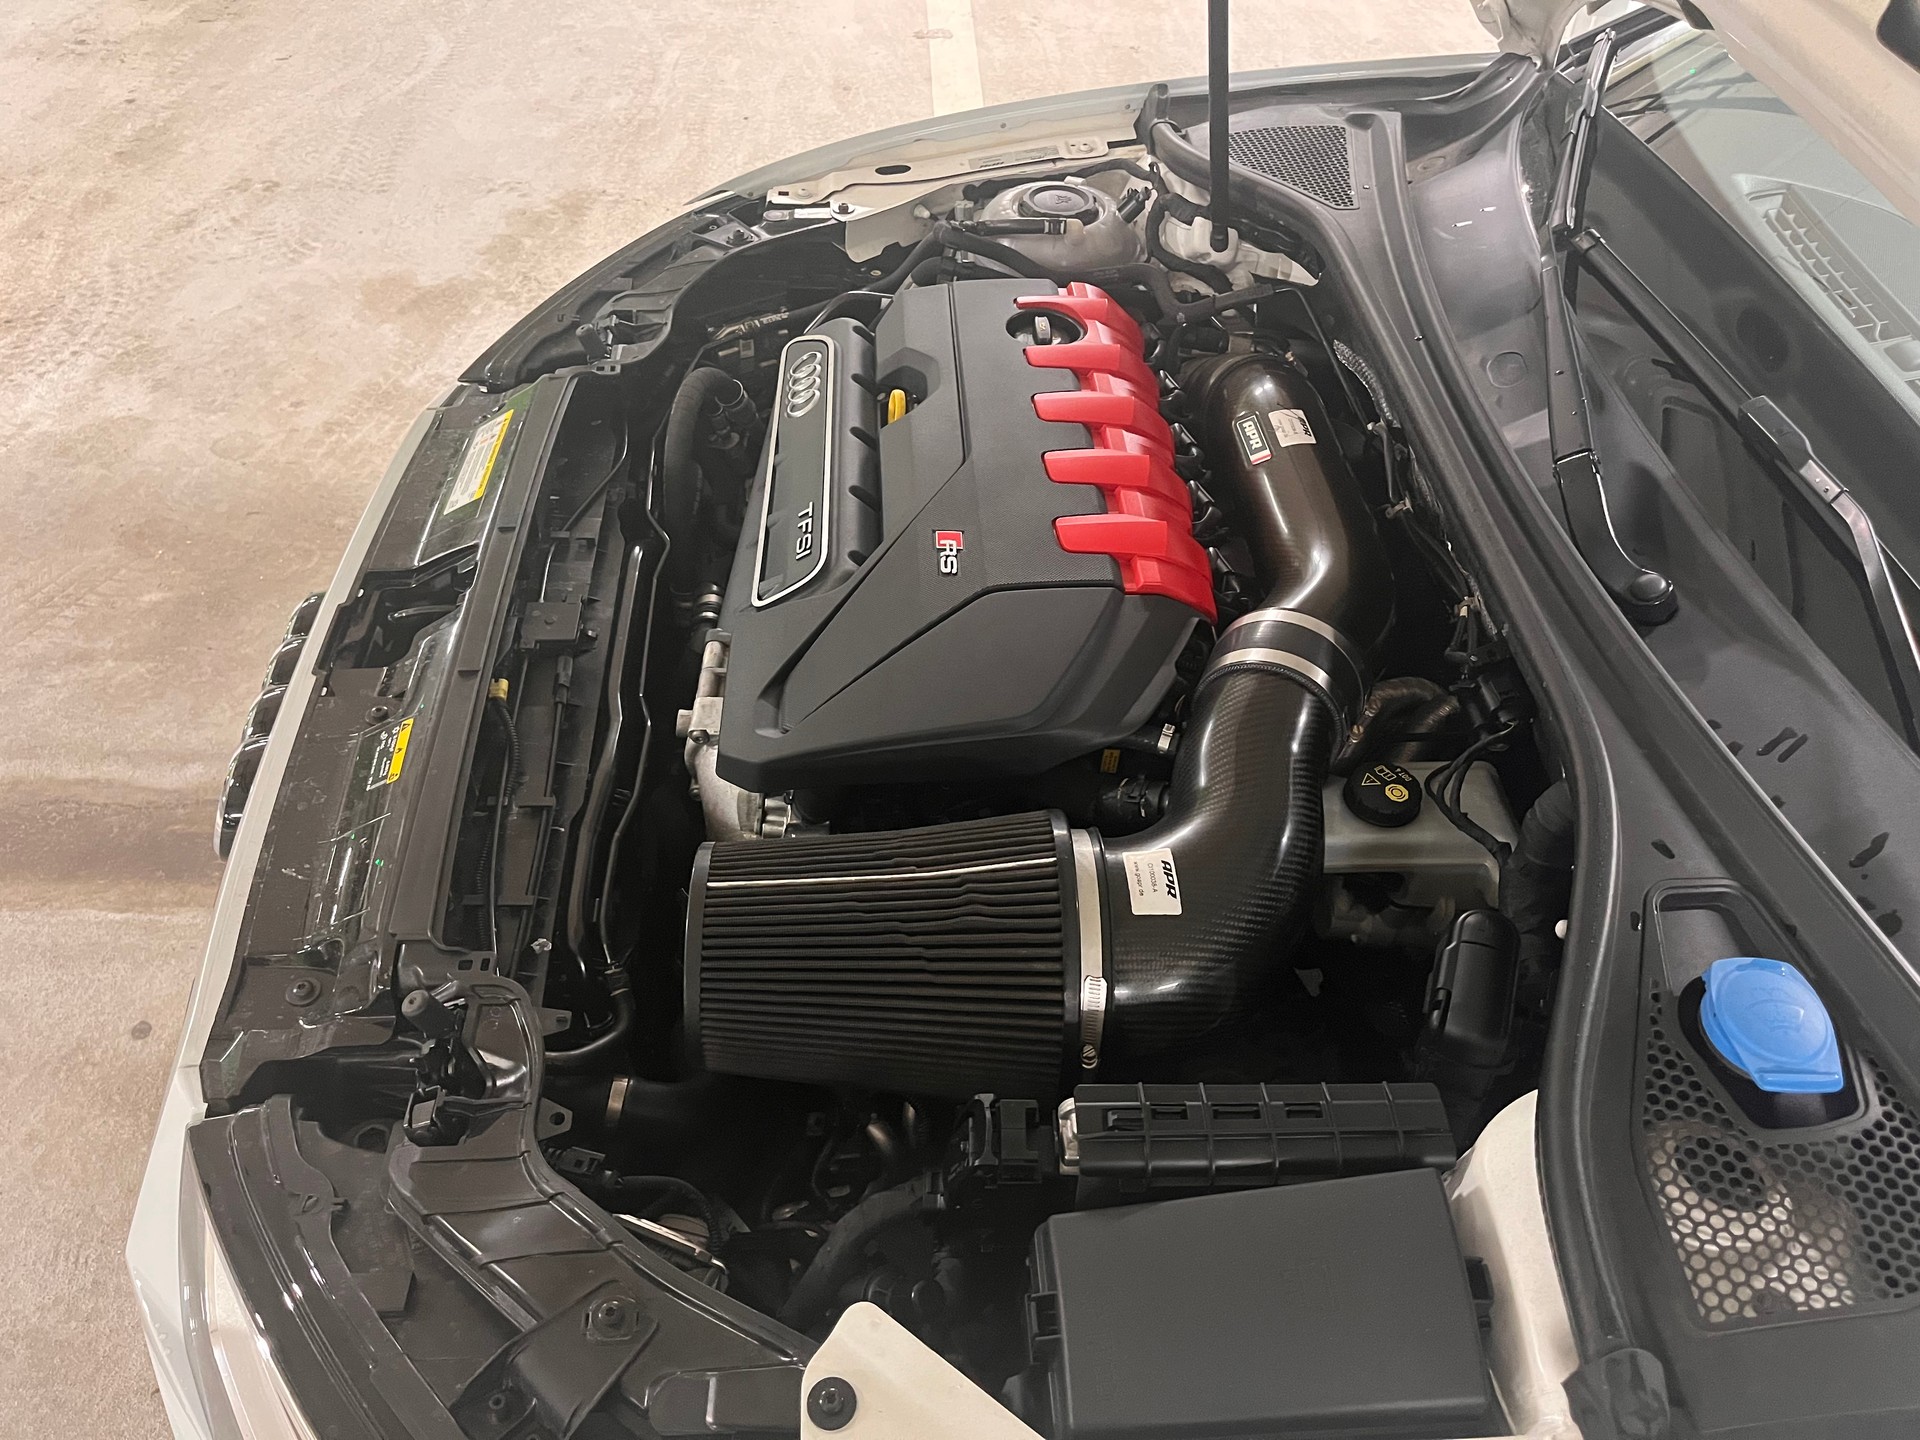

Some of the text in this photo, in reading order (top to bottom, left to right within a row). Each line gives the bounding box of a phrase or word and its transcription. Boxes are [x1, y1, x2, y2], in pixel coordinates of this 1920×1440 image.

[1242, 420, 1263, 450] APR
[795, 501, 814, 560] TFSI
[938, 538, 959, 575] RS
[1160, 859, 1178, 899] APR
